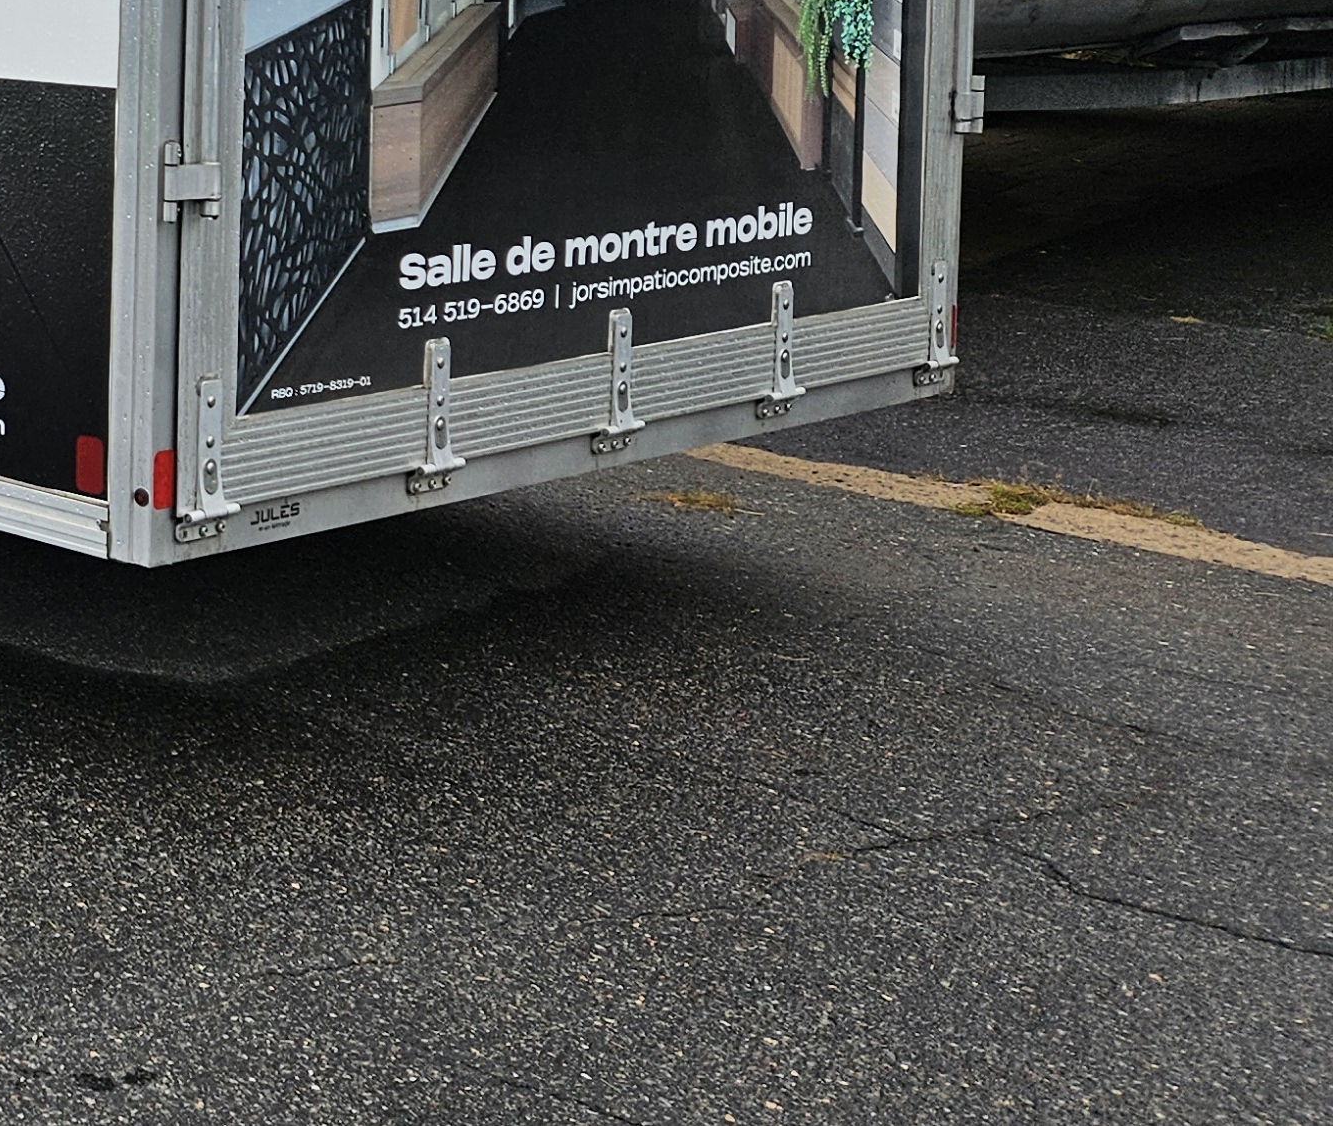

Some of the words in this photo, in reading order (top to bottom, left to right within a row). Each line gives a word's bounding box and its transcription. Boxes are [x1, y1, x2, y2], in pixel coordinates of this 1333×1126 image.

[399, 244, 496, 290] Salle
[506, 235, 555, 275] de
[564, 221, 697, 269] montre
[706, 202, 813, 247] mobile
[398, 304, 437, 329] 514
[443, 288, 545, 323] 519-6869
[569, 251, 812, 310] jorsimpatiocomposite.com
[300, 376, 371, 396] 5719-8319-01
